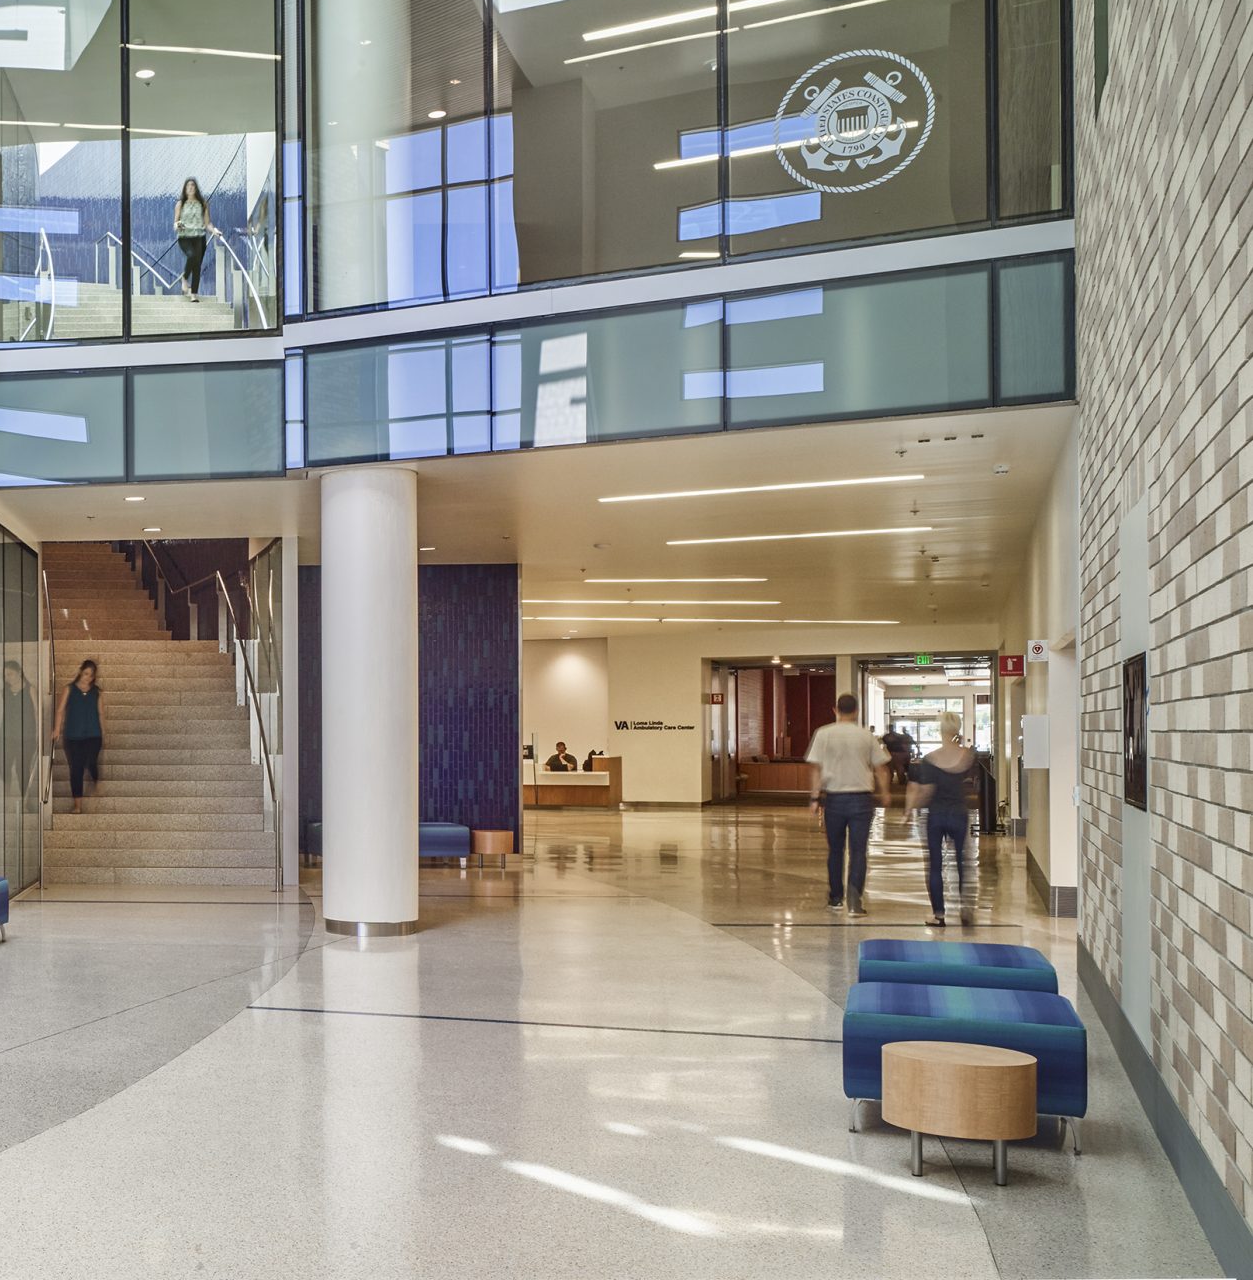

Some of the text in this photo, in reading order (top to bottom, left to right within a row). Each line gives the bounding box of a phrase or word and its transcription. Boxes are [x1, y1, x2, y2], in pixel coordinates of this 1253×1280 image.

[824, 91, 854, 114] STATES
[857, 90, 886, 107] COAST
[842, 144, 866, 154] 1790
[917, 656, 930, 665] EXIT
[614, 721, 629, 730] VA
